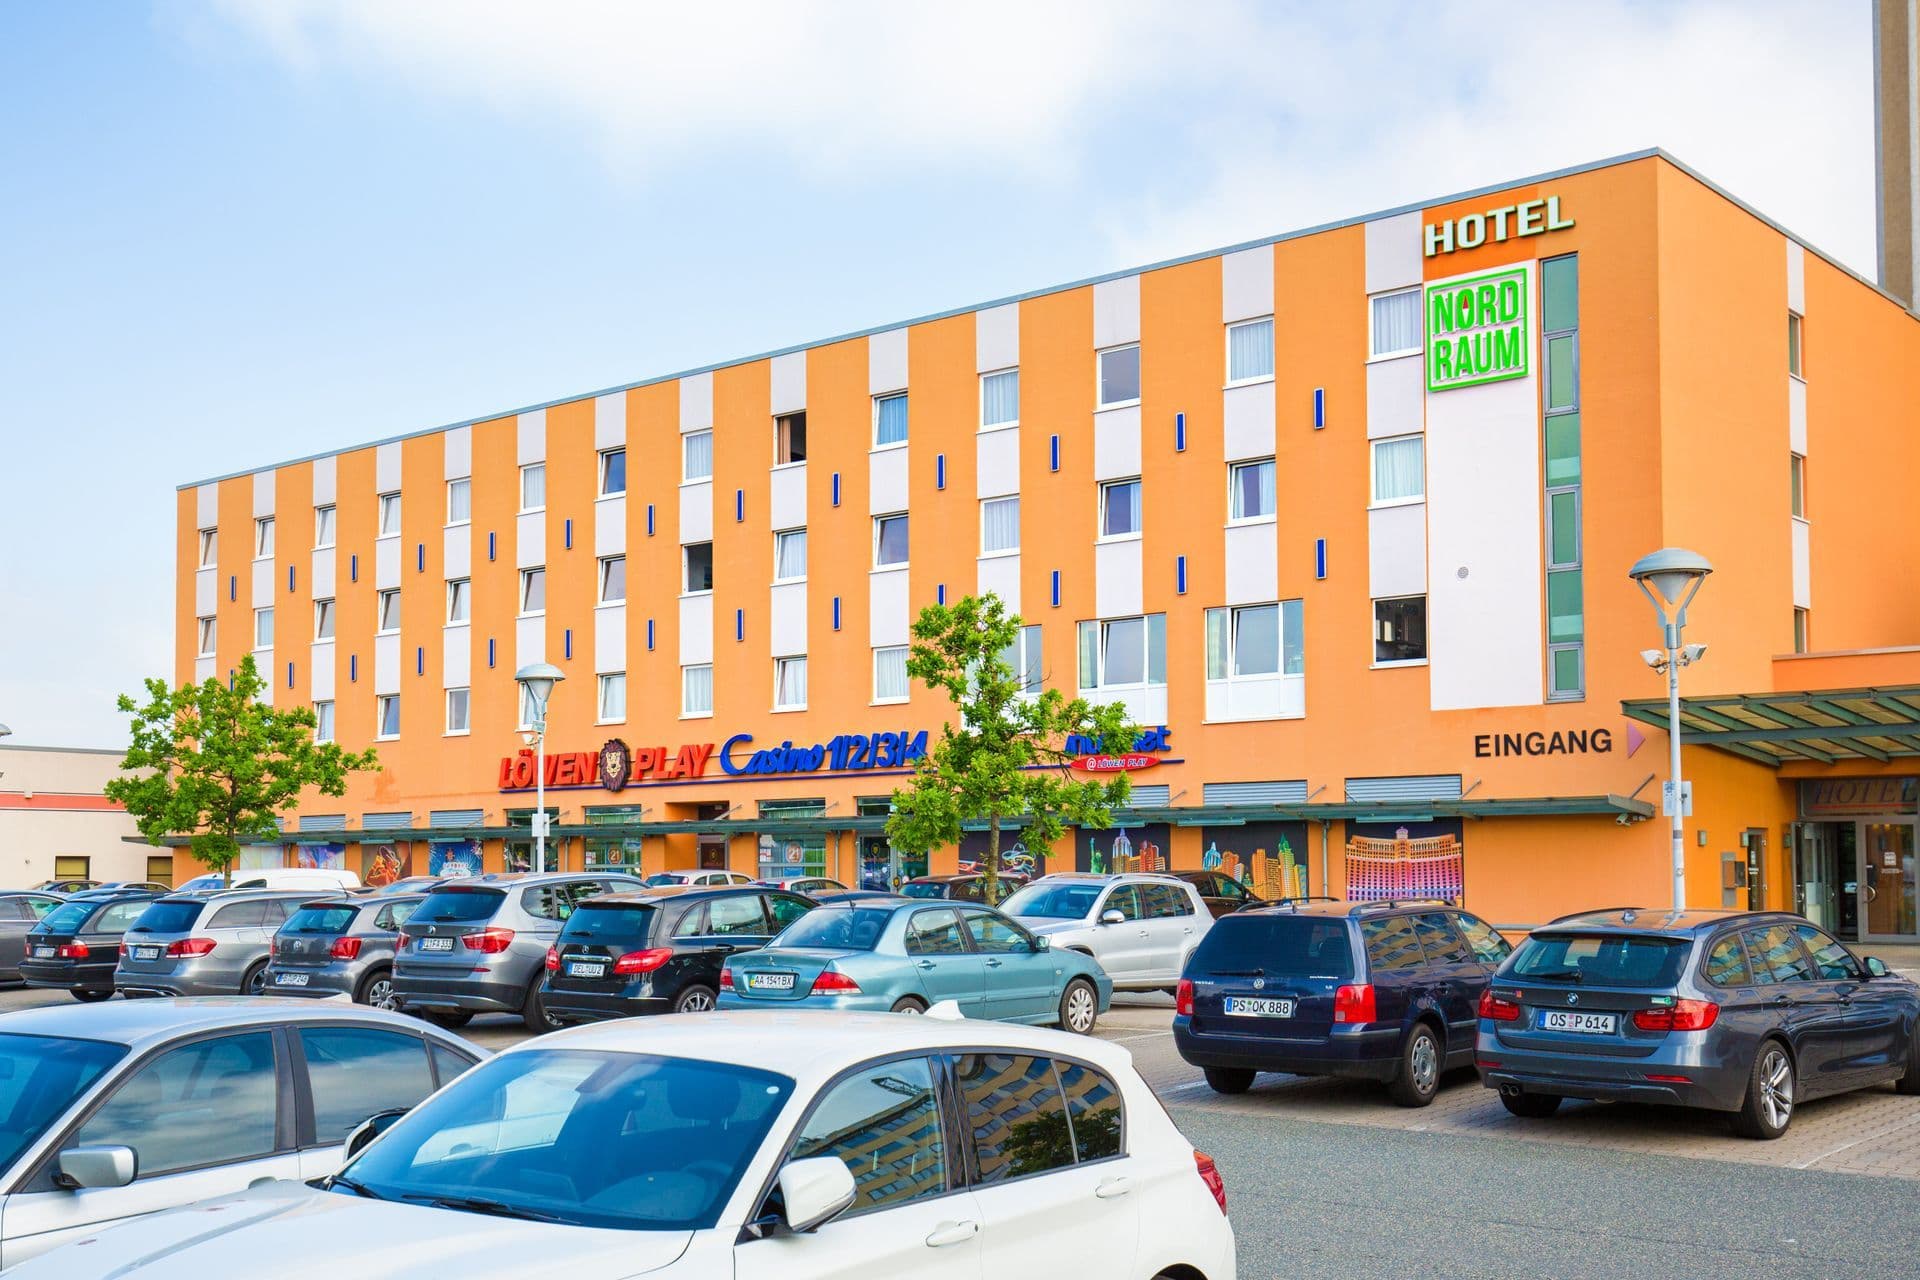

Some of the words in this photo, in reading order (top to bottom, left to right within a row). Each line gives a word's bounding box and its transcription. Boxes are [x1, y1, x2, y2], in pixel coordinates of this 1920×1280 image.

[1424, 195, 1576, 257] HOTEL
[1433, 279, 1520, 335] NORD
[1434, 326, 1520, 381] RAUM
[498, 749, 600, 788] LÖWEN
[632, 743, 715, 781] PLAY
[720, 733, 826, 777] Casino
[1474, 728, 1612, 758] EINGANG
[1813, 777, 1919, 804] HOTEL
[1232, 999, 1246, 1011] PS
[1252, 1000, 1266, 1013] OK
[1269, 1001, 1289, 1014] 888
[1550, 1013, 1567, 1027] OS
[1574, 1015, 1583, 1028] P
[1585, 1015, 1609, 1031] 614
